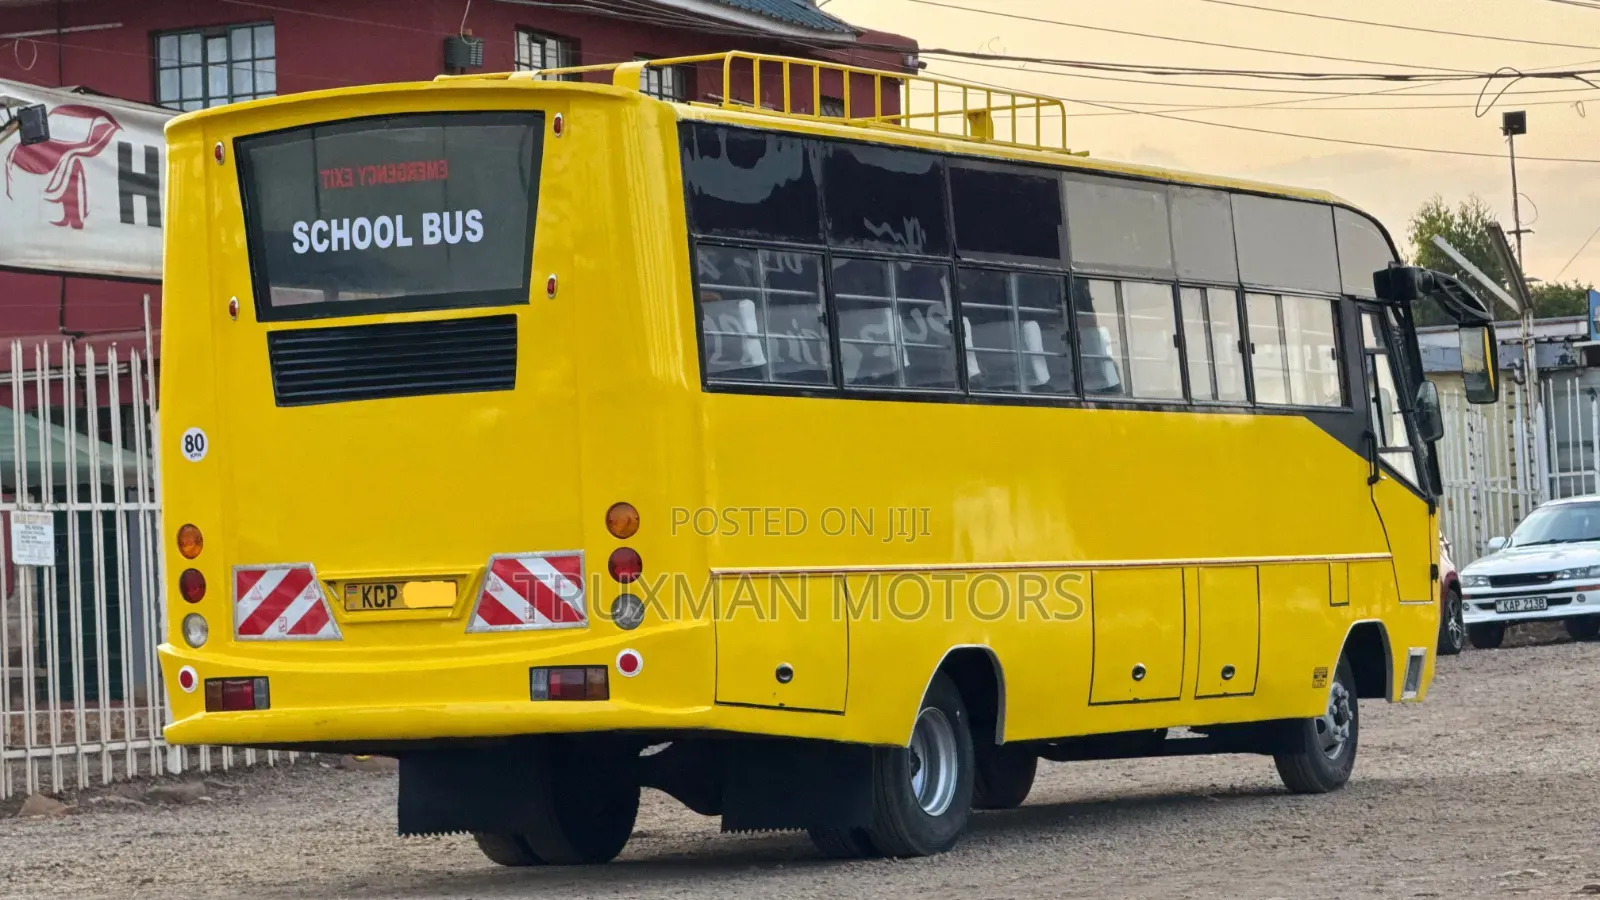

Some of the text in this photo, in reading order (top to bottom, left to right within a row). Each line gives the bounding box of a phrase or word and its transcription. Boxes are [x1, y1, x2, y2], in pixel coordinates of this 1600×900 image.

[292, 209, 484, 254] SCHOOL BUS
[185, 433, 204, 453] 80
[362, 584, 398, 608] KCP
[1503, 597, 1545, 612] KAP 213B
